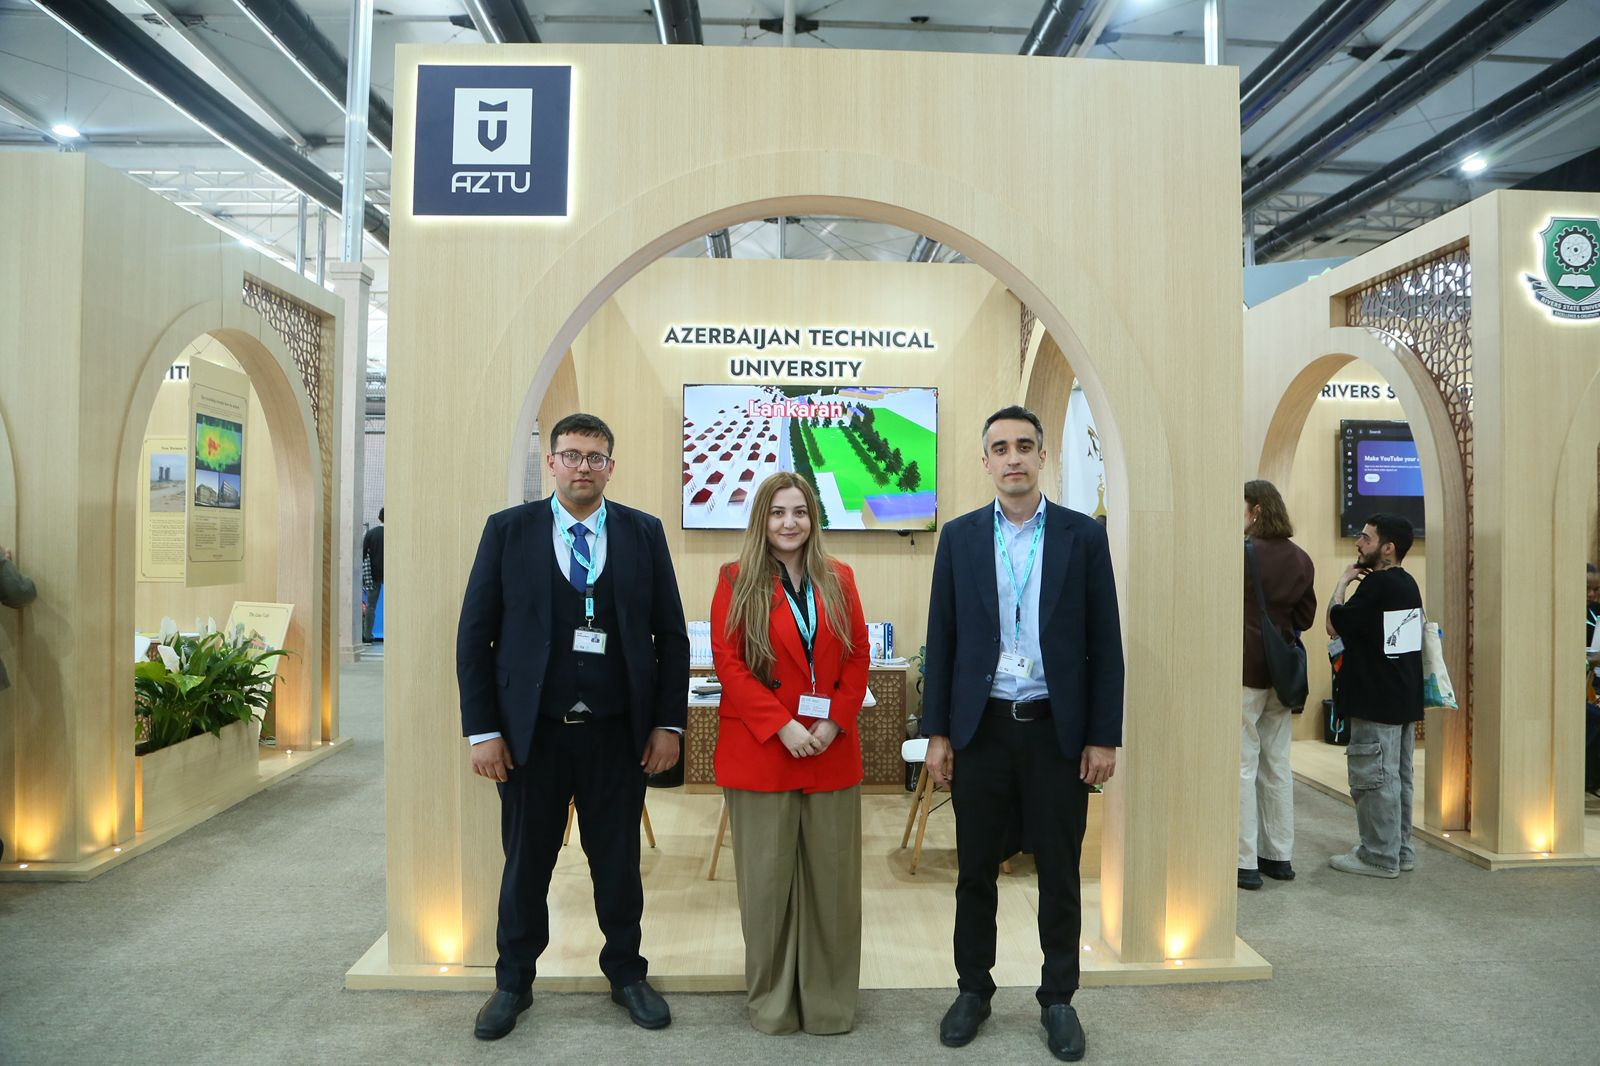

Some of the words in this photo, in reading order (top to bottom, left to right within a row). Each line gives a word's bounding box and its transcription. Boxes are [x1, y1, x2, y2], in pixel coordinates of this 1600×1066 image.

[451, 171, 531, 194] AZTU
[1540, 297, 1562, 309] RIVERS
[1562, 304, 1580, 312] STATE
[664, 327, 800, 350] AZERBAIJAN
[808, 329, 935, 349] TECHNICAL
[730, 359, 863, 378] UNIVERSITY
[1321, 384, 1381, 399] RIVERS
[749, 399, 844, 418] Lankaran
